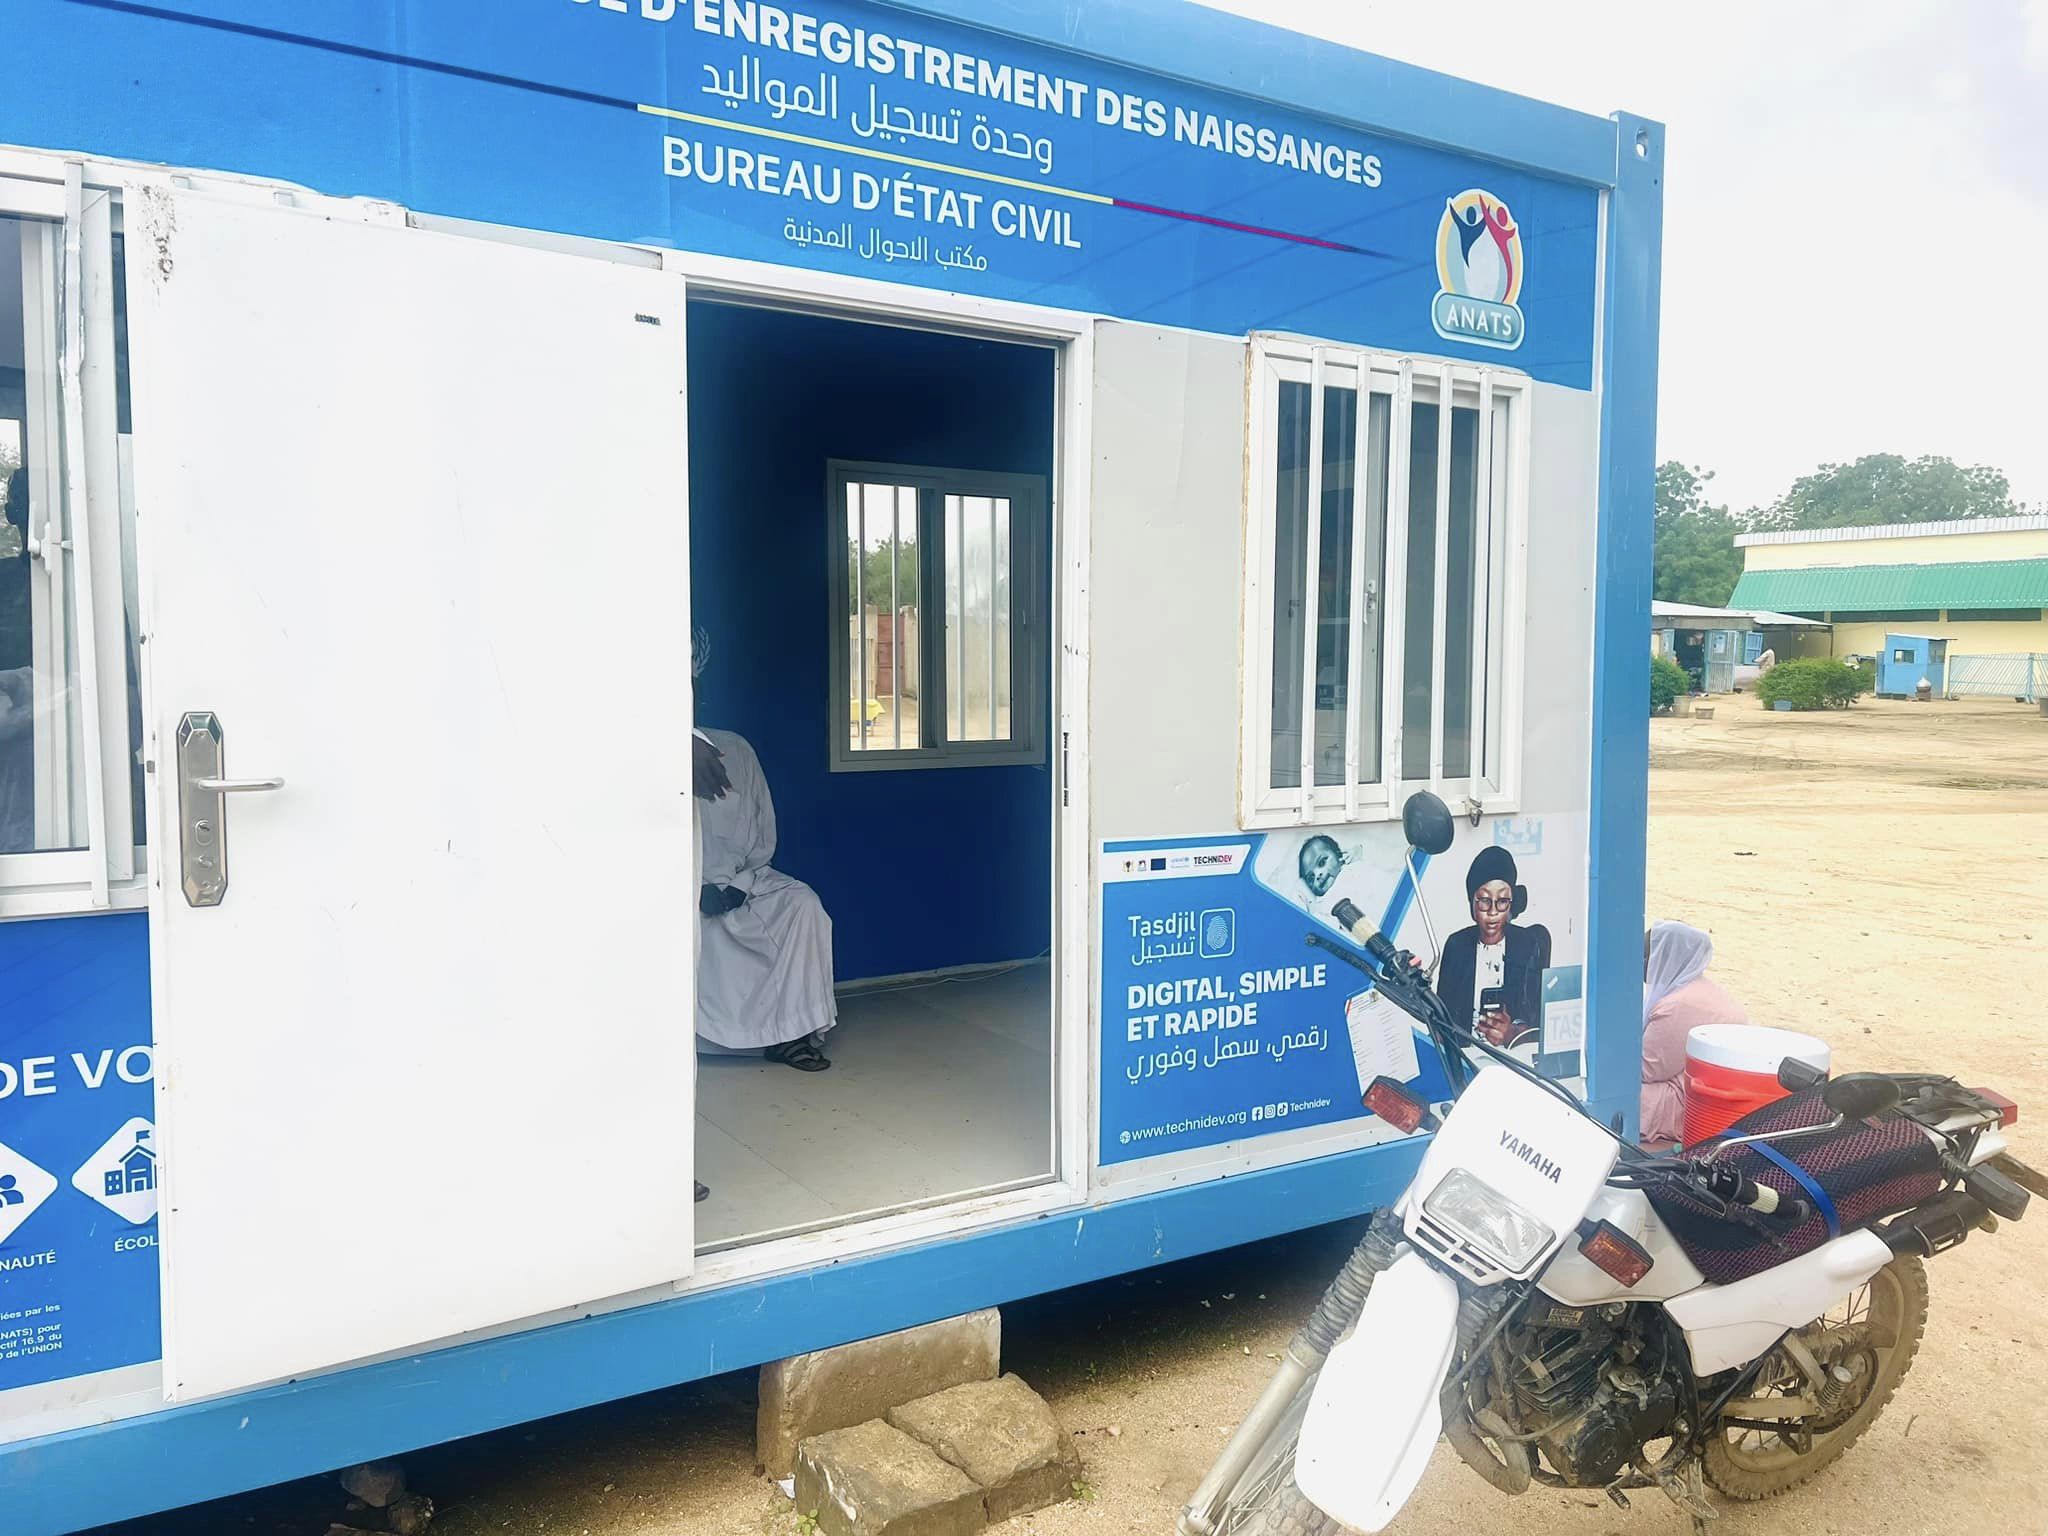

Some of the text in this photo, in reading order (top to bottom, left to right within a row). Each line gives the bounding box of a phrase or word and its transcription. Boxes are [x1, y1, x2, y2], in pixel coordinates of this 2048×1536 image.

[640, 0, 1383, 188] DENREGISTREMENT DES NAISSANCES
[702, 55, 1053, 175] وحدة تسجيل المواليد
[662, 135, 1082, 249] BUREAU D'ÉTAT CIVIL
[783, 216, 989, 272] مكتب الاحوال المدنية
[1446, 303, 1512, 336] ANATS
[1128, 911, 1196, 939] Tasdjil
[1131, 936, 1196, 966] تسجيل
[1127, 964, 1327, 1010] DIGITAL, SIMPLE
[1127, 1002, 1258, 1042] ET RAPIDE
[1126, 1044, 1197, 1085] وفوري
[1203, 1035, 1259, 1068] سهل
[1131, 1098, 1331, 1141] www.technidev.org Technidev
[1499, 1129, 1562, 1184] YAMAHA
[25, 1307, 42, 1318] par
[45, 1304, 61, 1313] les
[38, 1323, 61, 1335] pour
[5, 1350, 19, 1359] de
[21, 1341, 62, 1355] l'UNION
[22, 1334, 45, 1346] 16.9
[48, 1333, 62, 1341] du
